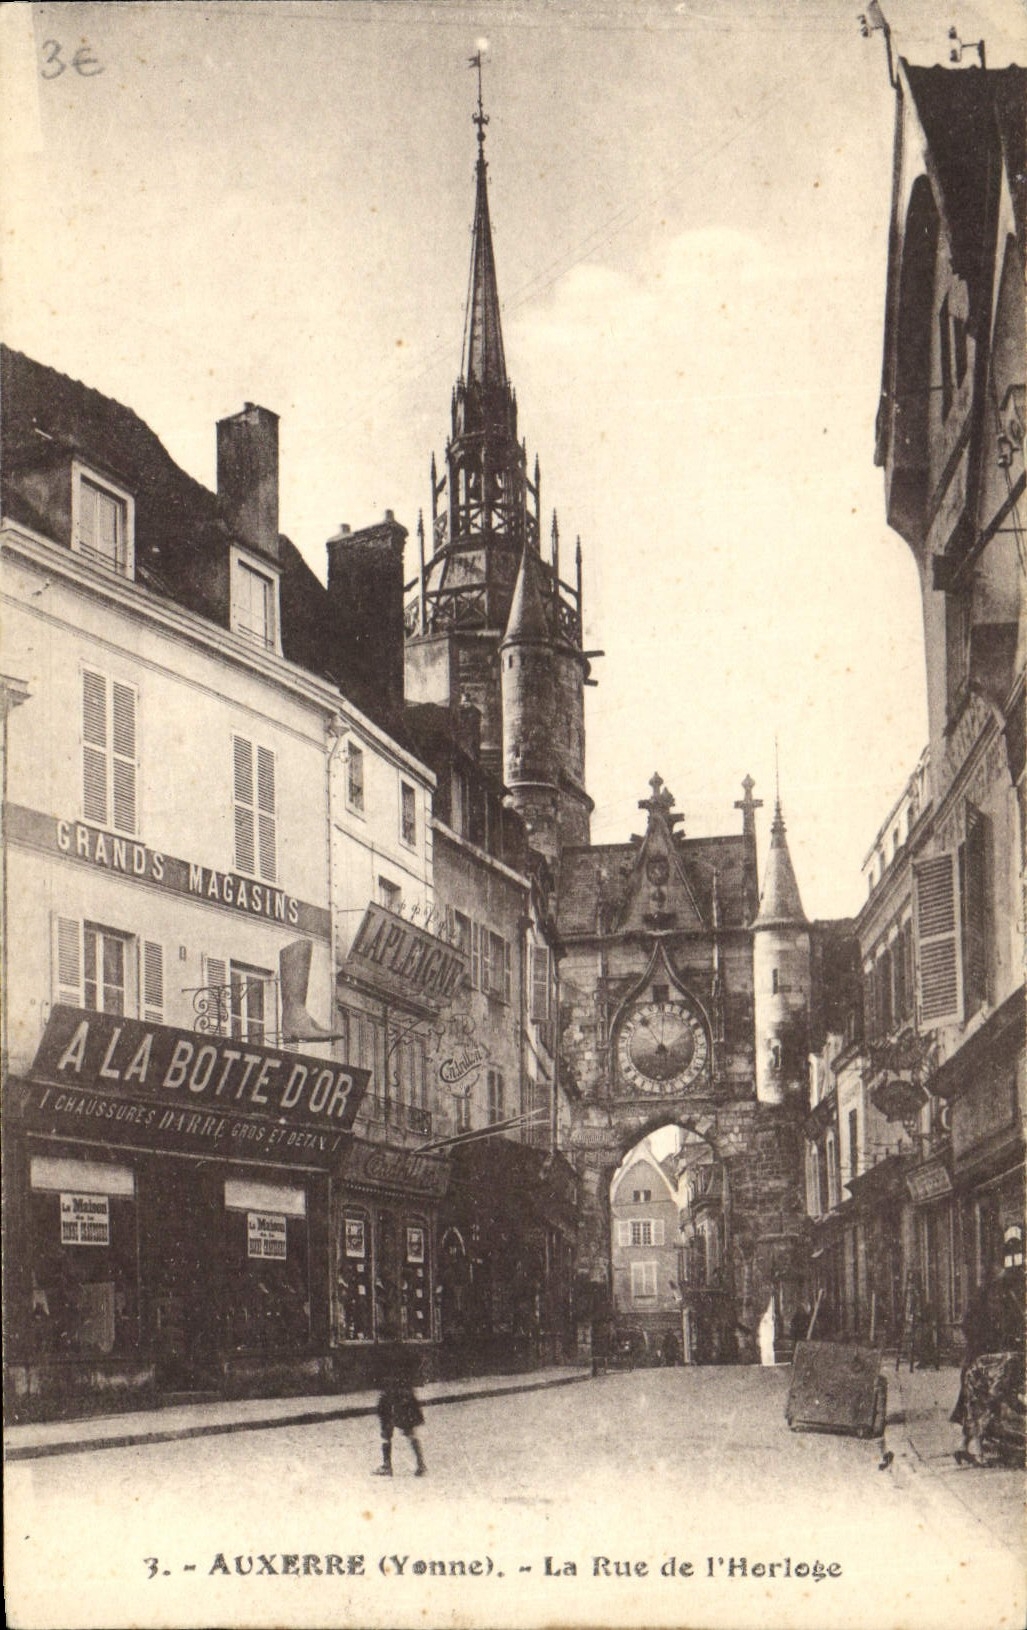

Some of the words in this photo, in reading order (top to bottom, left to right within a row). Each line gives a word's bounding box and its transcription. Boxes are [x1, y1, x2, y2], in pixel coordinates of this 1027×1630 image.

[41, 39, 107, 80] 3€
[56, 821, 165, 882] GRANDS
[188, 863, 300, 924] MAGASINS
[58, 1021, 89, 1074] A
[100, 1027, 154, 1084] LA
[162, 1040, 282, 1104] BOTTE
[280, 1065, 354, 1119] D'OR
[54, 1094, 156, 1125] CHAUSSURES
[231, 1121, 266, 1142] GROS
[268, 1128, 285, 1144] ET
[72, 1197, 108, 1215] Maison
